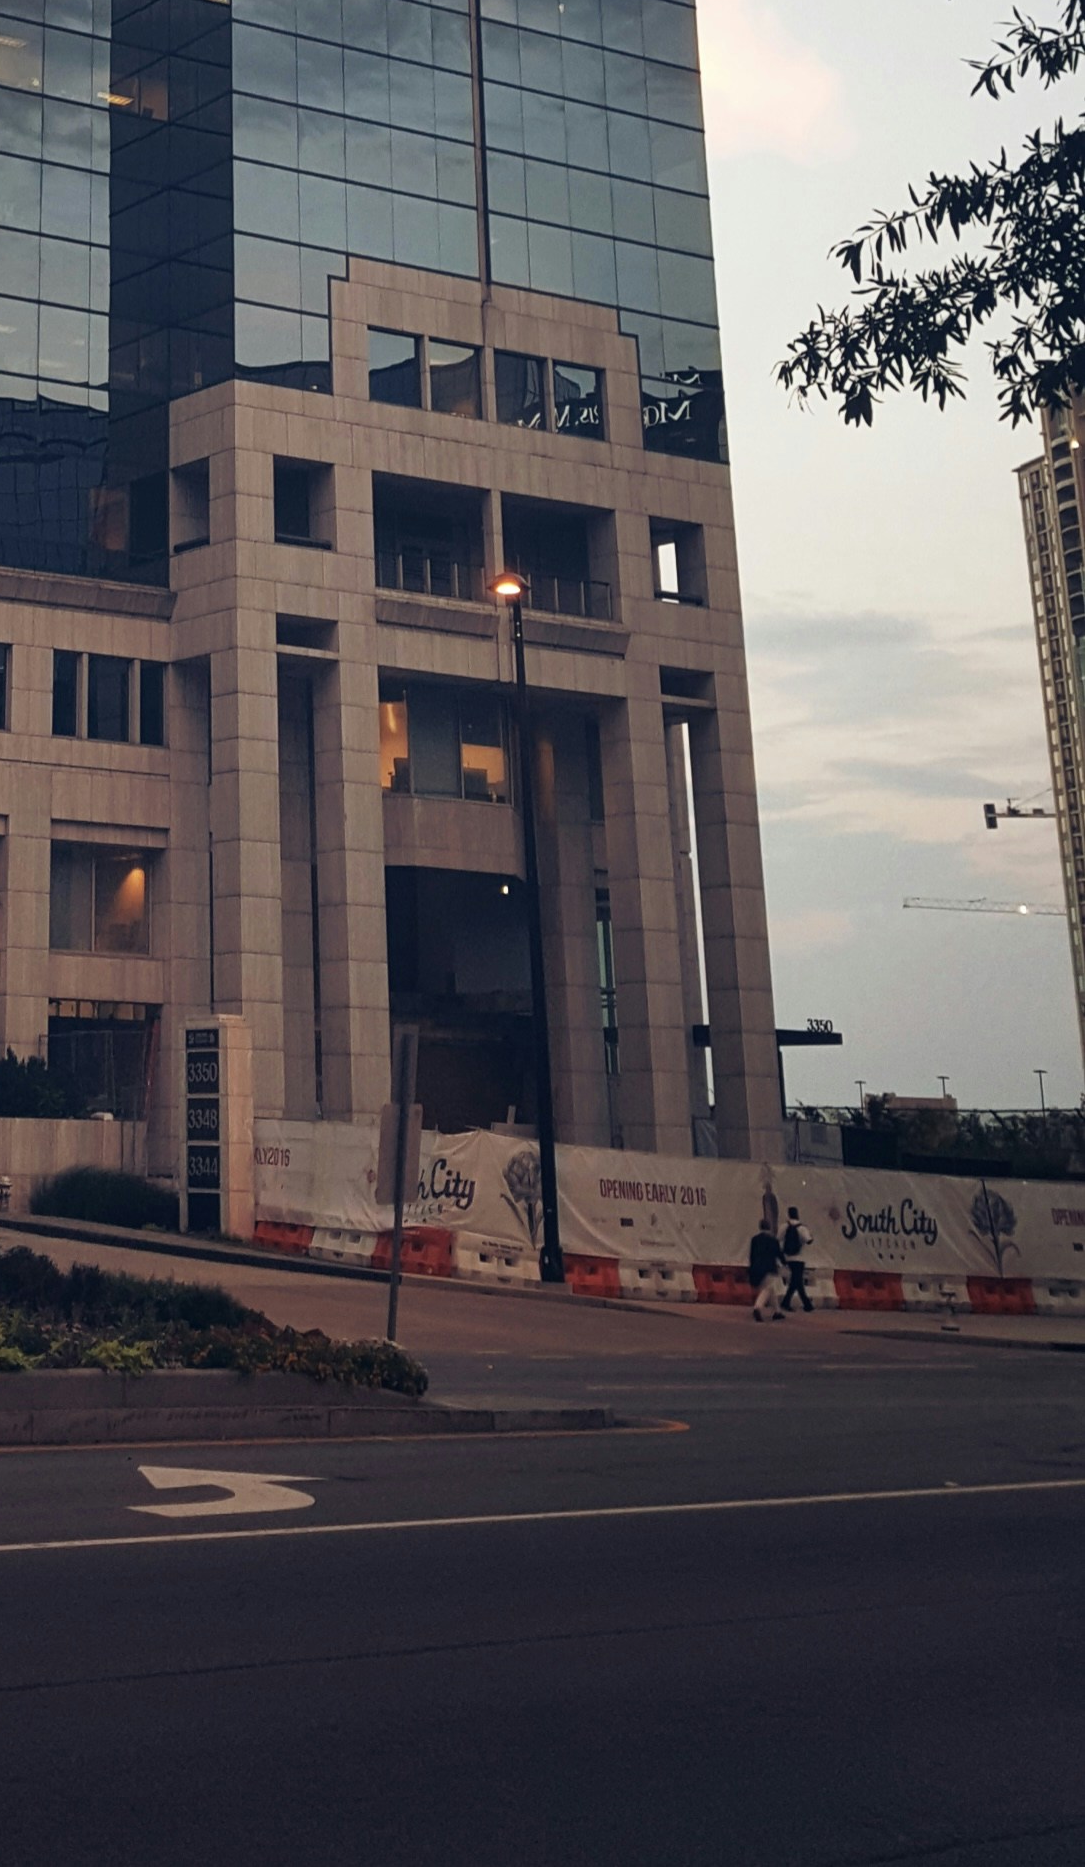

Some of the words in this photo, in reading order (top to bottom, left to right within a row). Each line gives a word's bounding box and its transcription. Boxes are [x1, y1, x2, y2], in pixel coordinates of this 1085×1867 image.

[806, 1017, 834, 1033] 3350
[187, 1062, 218, 1082] 3350
[187, 1108, 218, 1129] 3348
[187, 1156, 218, 1177] 3344
[430, 1158, 476, 1210] City
[599, 1178, 644, 1202] OPENING
[644, 1182, 677, 1204] EARLY
[680, 1185, 707, 1206] 2016
[841, 1199, 900, 1240] South
[900, 1198, 938, 1246] City
